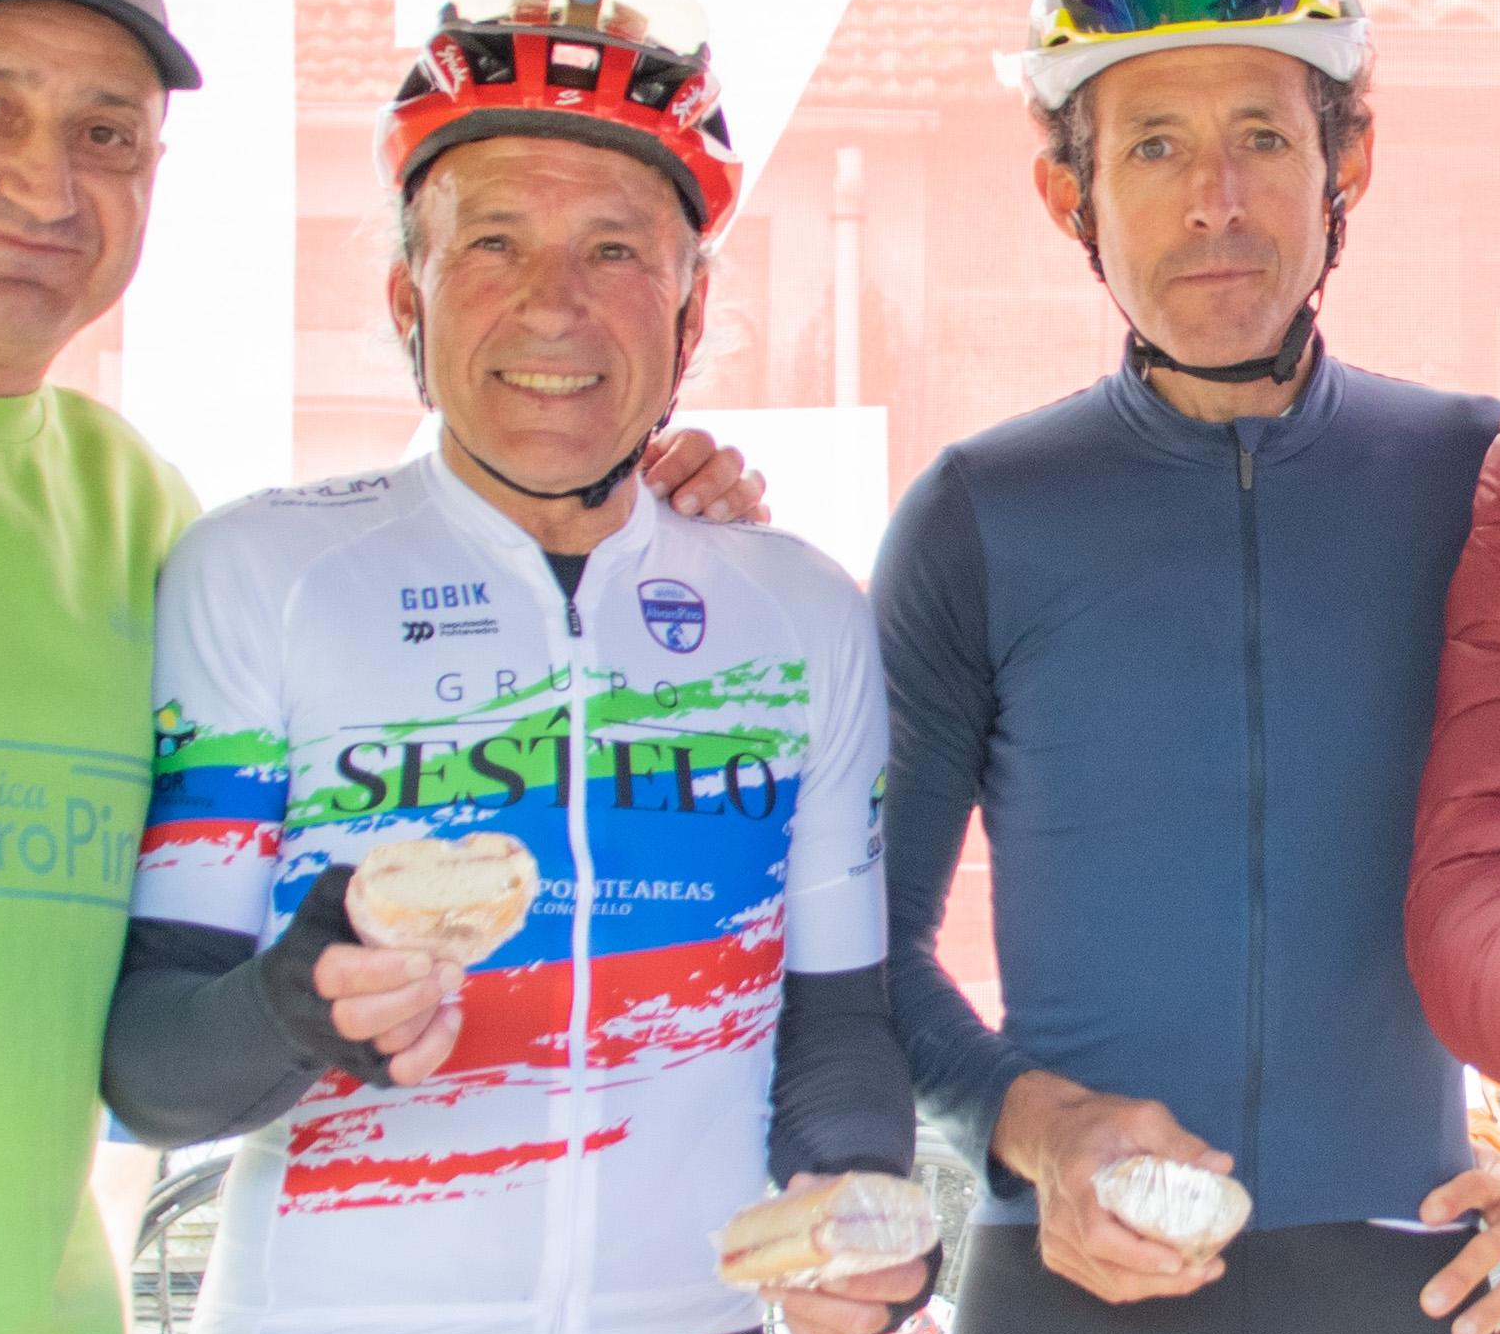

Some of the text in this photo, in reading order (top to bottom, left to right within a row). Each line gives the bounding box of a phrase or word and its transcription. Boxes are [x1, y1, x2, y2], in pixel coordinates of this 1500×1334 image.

[401, 581, 490, 610] GOBIK
[434, 661, 681, 709] GRUPO
[331, 729, 777, 822] SESTELO
